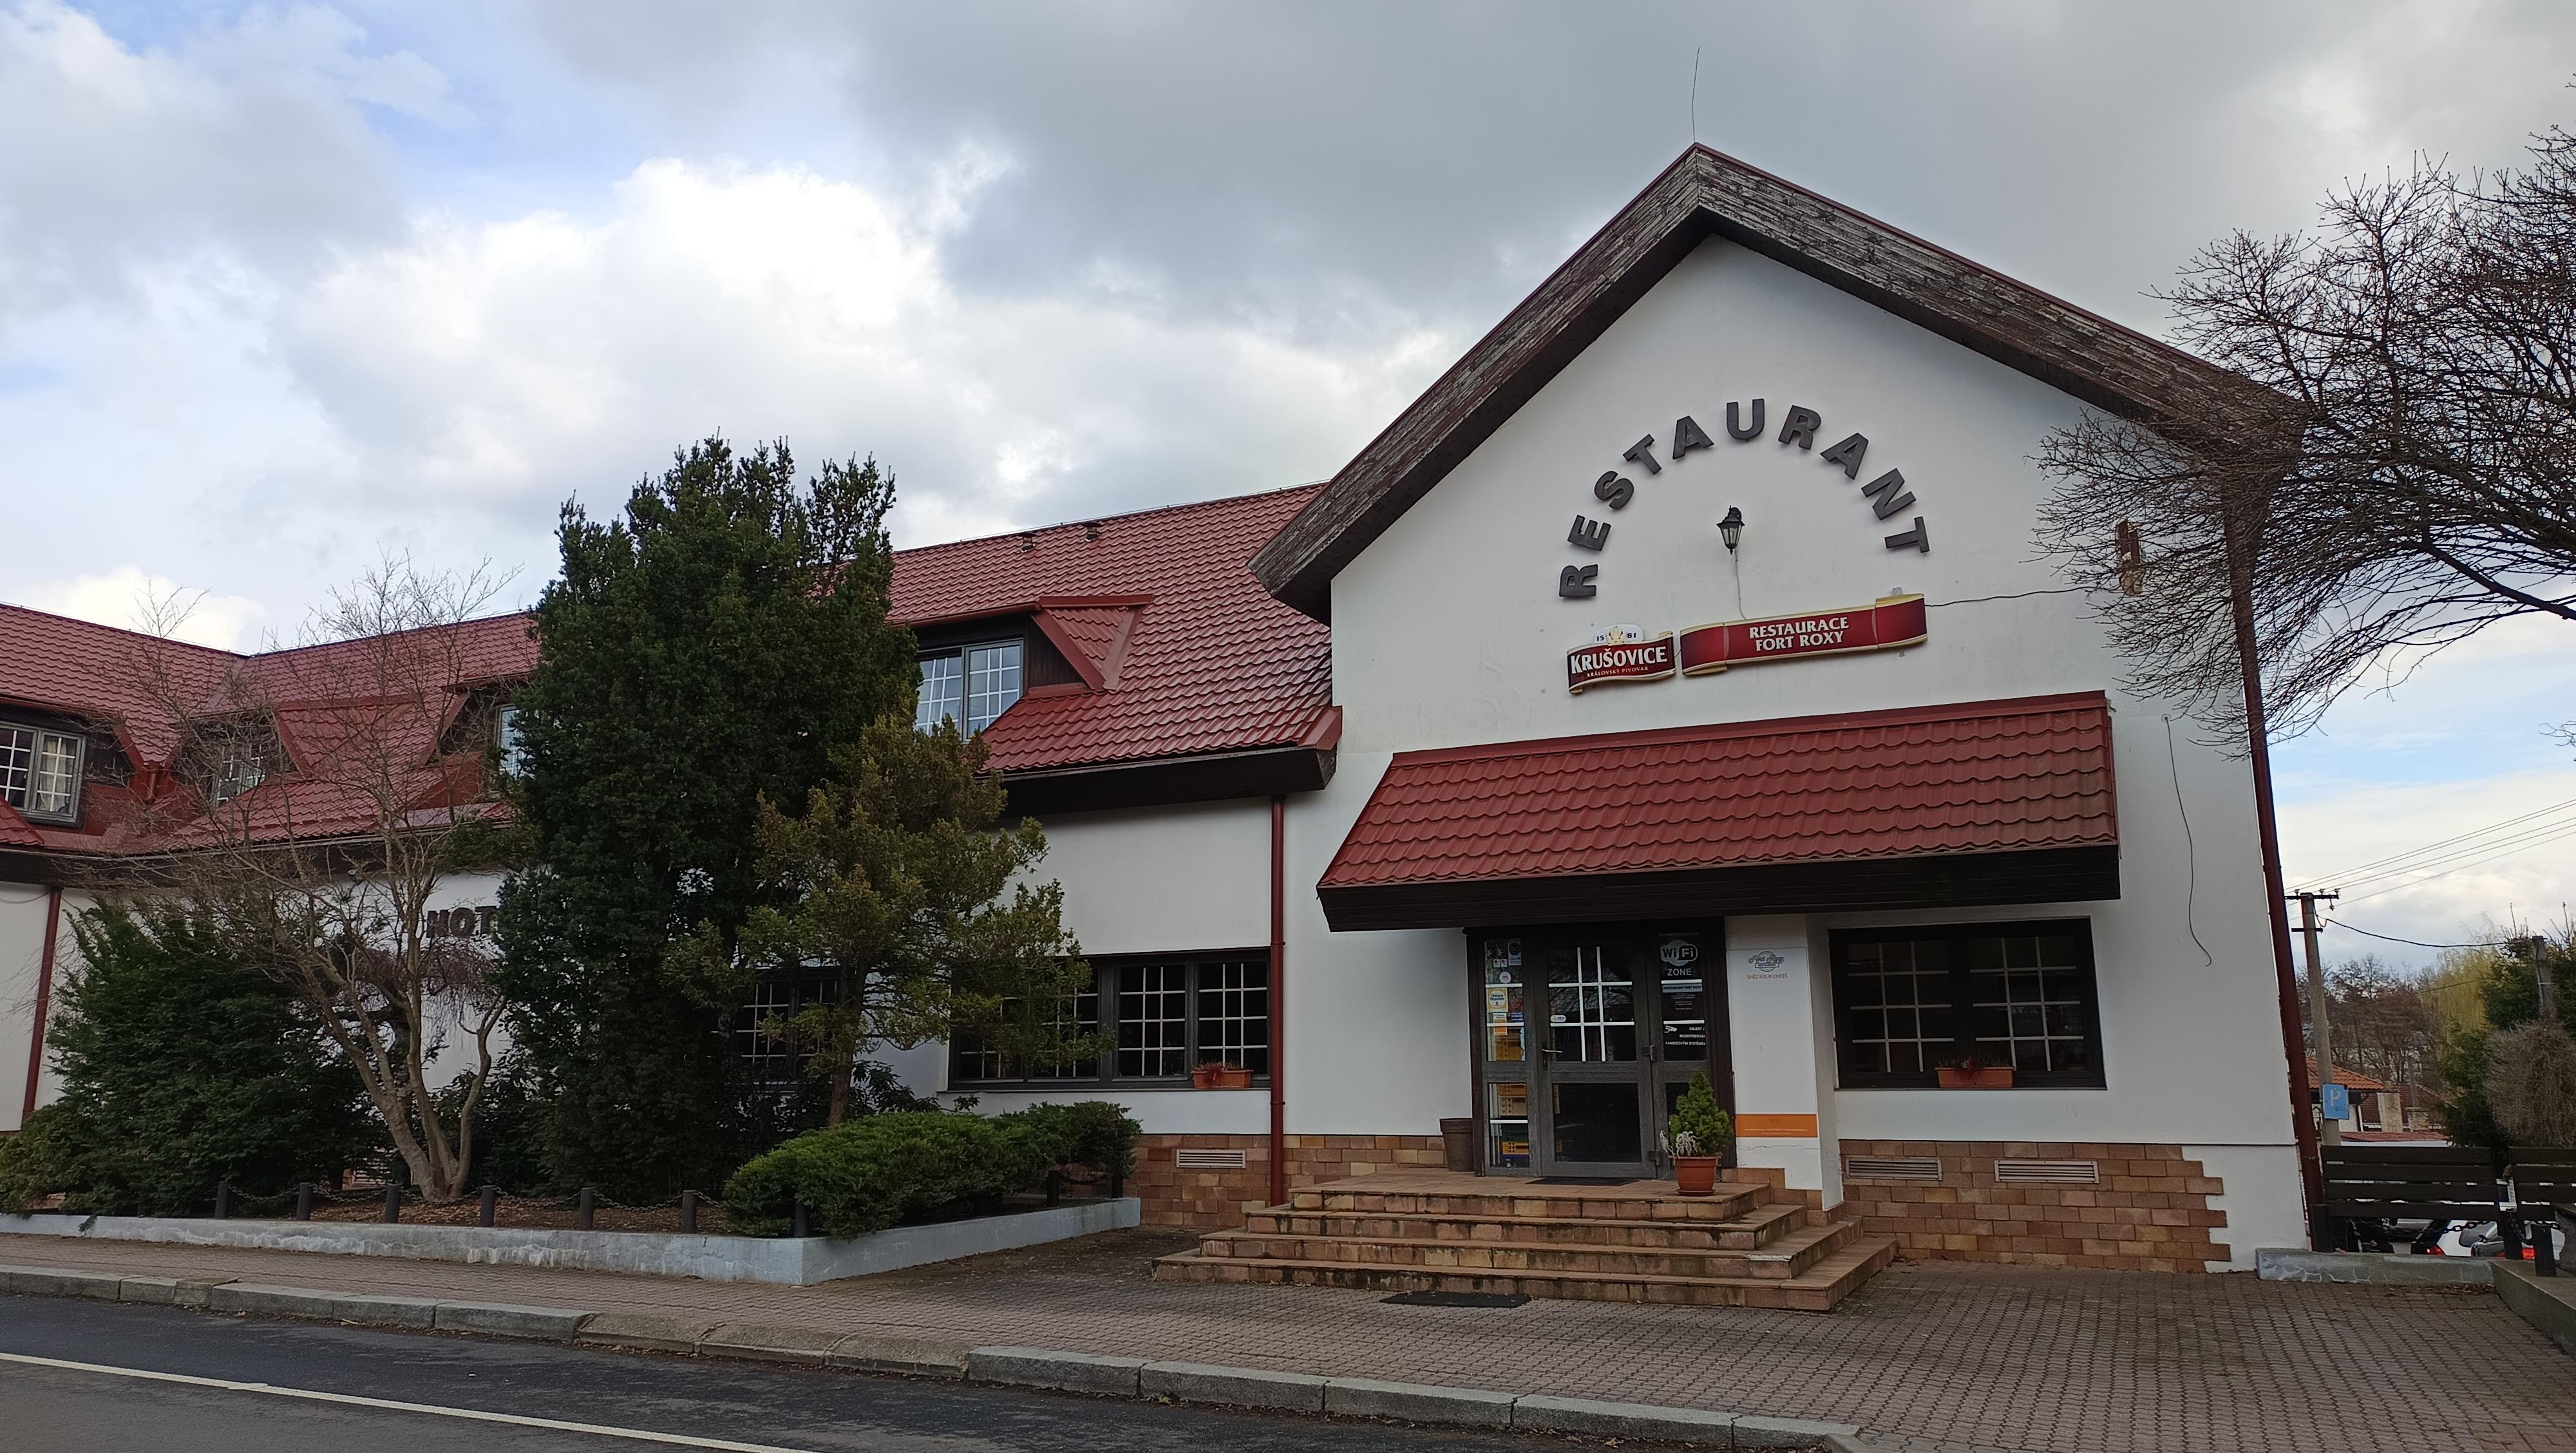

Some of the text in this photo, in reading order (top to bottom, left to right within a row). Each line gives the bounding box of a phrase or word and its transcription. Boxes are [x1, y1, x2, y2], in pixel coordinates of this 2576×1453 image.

[1558, 398, 1930, 598] RESTAURANT
[1749, 616, 1850, 638] RESTAURACE
[1756, 631, 1844, 652] FORT ROXY
[1570, 646, 1667, 674] KRUŠOVICE
[1587, 669, 1620, 678] KRÁLOVSKÝ
[426, 906, 498, 938] HOT
[1667, 968, 1692, 976] ZONE
[2330, 1088, 2340, 1106] P
